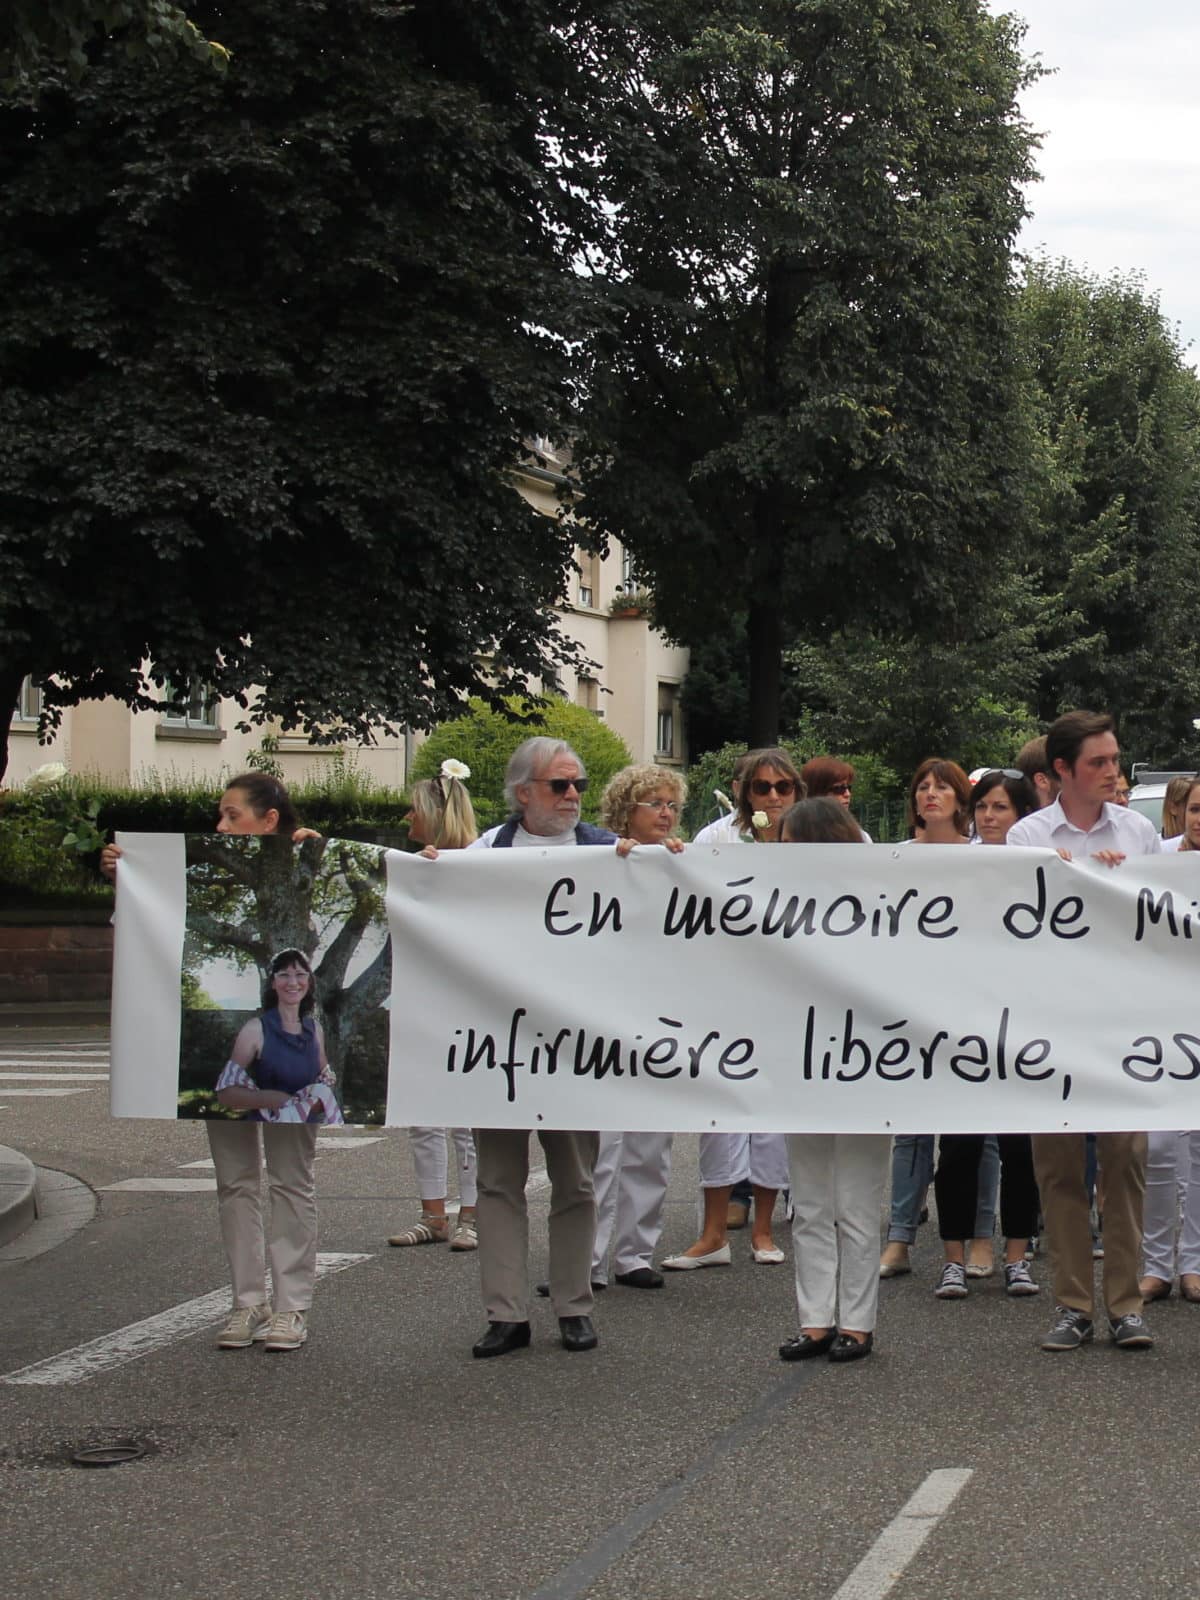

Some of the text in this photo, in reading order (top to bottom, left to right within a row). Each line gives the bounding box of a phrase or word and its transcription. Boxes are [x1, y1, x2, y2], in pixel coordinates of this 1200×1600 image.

[544, 878, 622, 937] En
[664, 876, 958, 939] mémoire
[1002, 866, 1090, 940] de
[447, 1008, 758, 1102] infirmière
[804, 1006, 1072, 1101] libérale,
